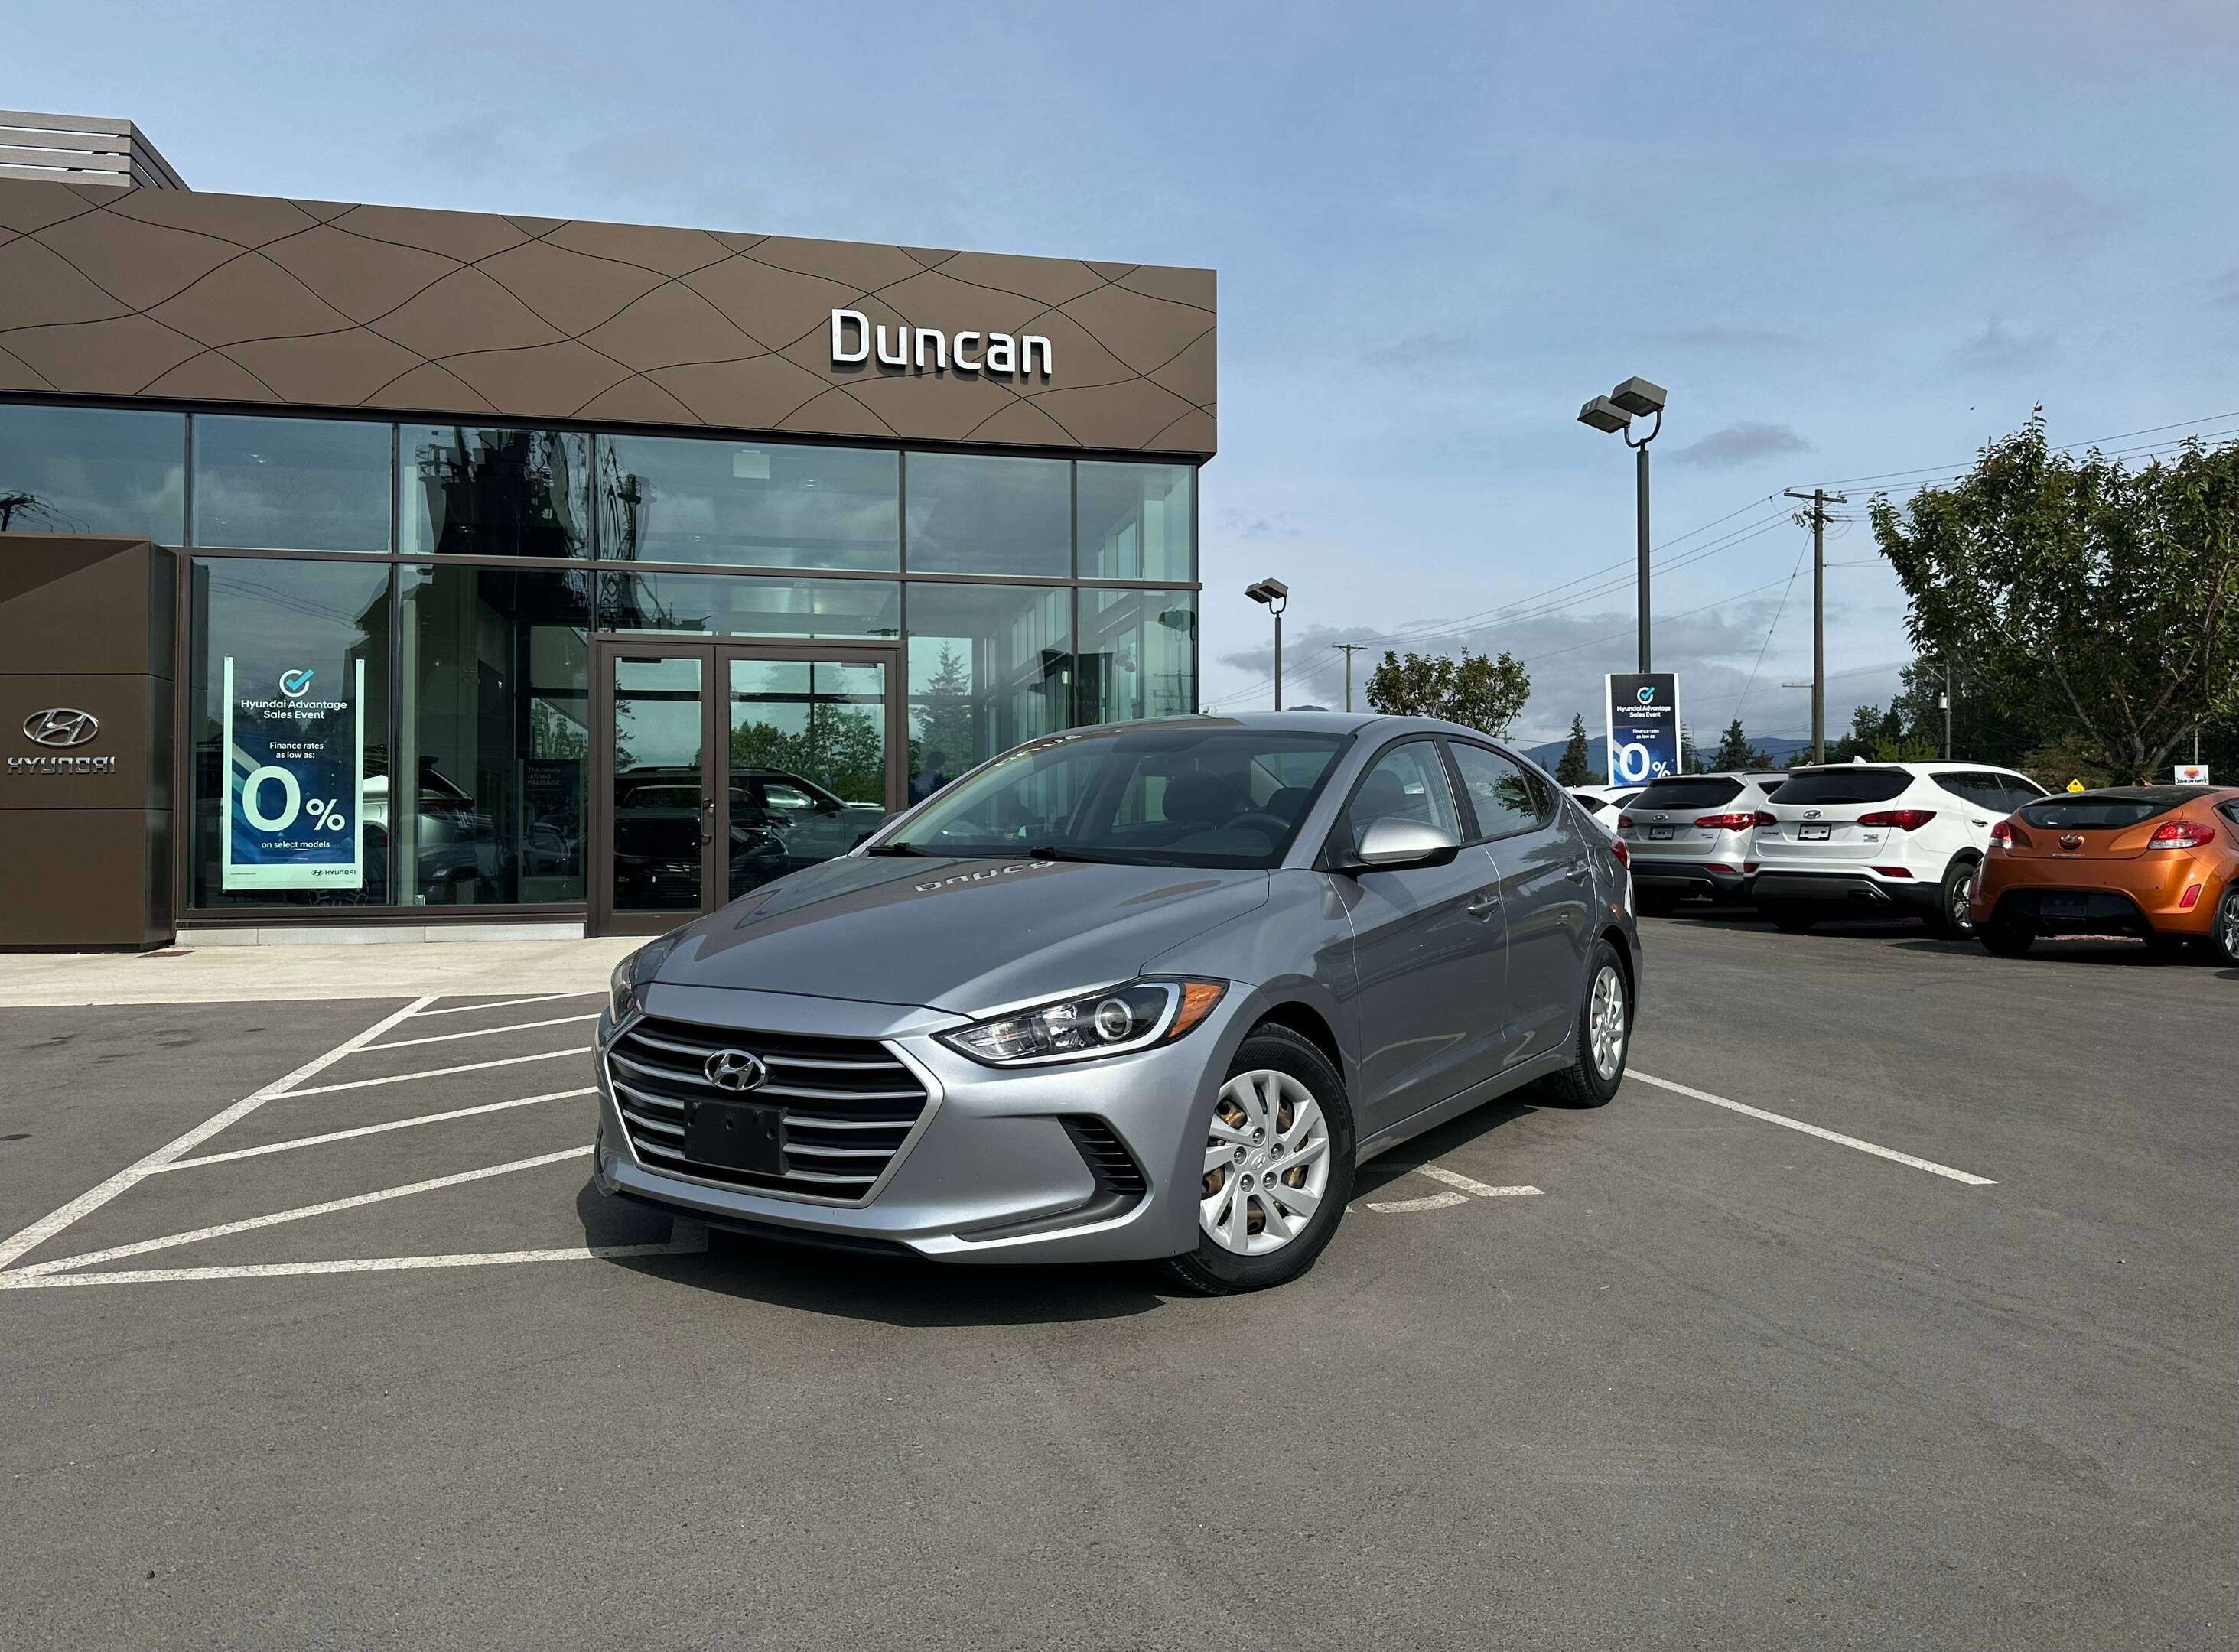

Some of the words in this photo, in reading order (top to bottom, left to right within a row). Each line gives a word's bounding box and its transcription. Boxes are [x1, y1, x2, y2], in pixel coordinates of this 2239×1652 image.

[831, 308, 1053, 375] Duncan
[241, 699, 287, 710] Hyundai
[288, 700, 347, 711] Advantage
[263, 711, 292, 719] Sales
[295, 711, 325, 719] Event
[269, 741, 301, 750] Finance
[287, 750, 302, 759] low
[7, 756, 116, 774] HYUNDAI
